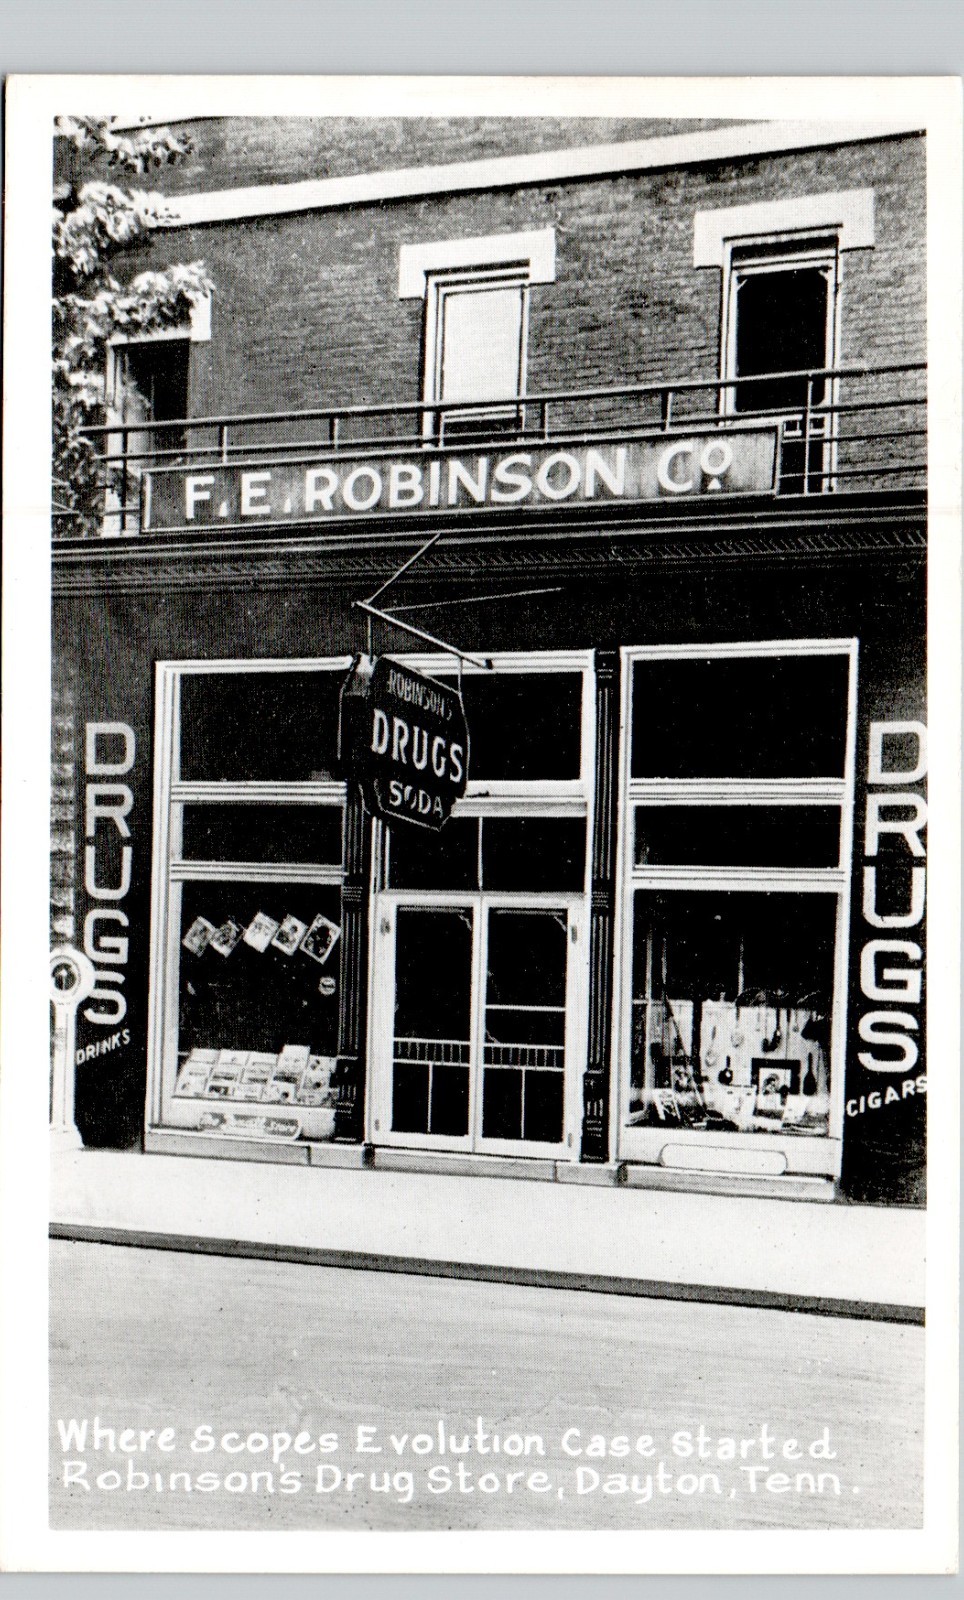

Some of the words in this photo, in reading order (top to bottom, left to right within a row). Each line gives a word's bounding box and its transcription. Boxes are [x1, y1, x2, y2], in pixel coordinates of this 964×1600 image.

[304, 447, 627, 513] ROBINSON
[371, 708, 463, 783] DRUGS
[389, 780, 443, 818] SODA
[84, 721, 137, 1026] DRUGS
[857, 721, 927, 1072] DRUGS
[75, 1028, 131, 1066] DRINKS
[845, 1075, 927, 1118] CIGARS
